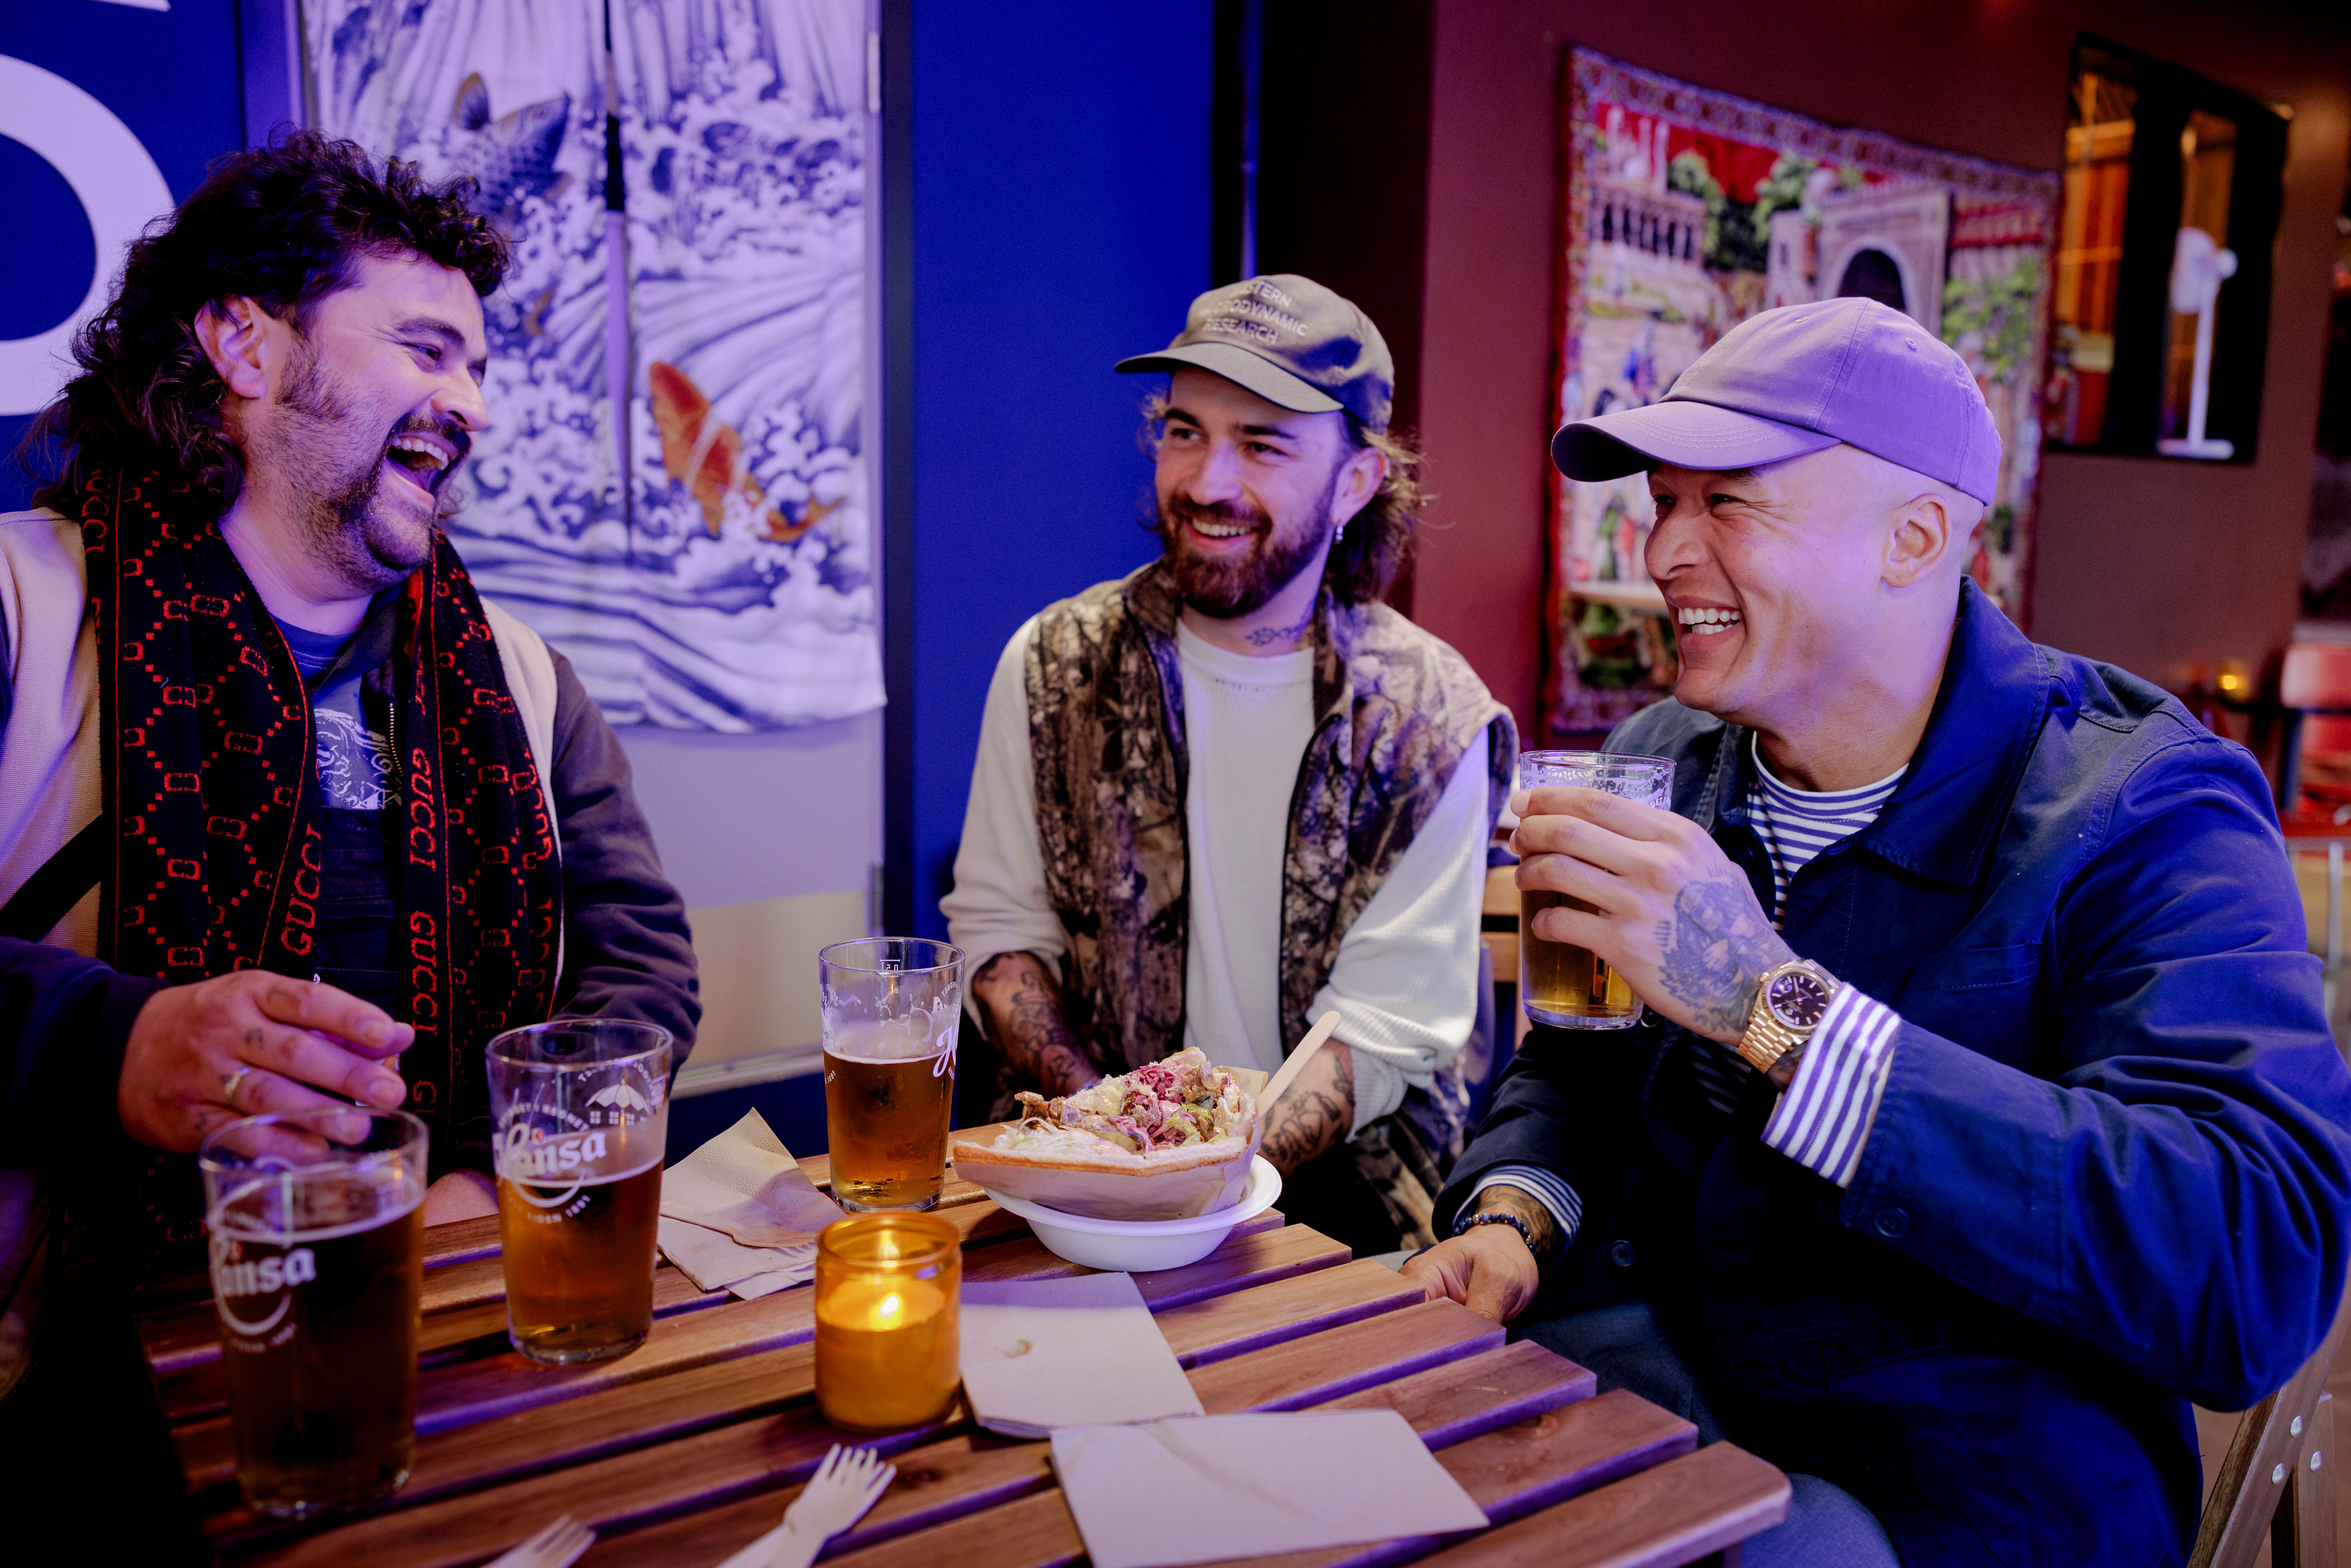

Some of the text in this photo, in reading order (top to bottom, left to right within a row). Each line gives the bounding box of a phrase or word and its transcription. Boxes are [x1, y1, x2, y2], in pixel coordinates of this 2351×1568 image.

[410, 747, 436, 873] GUCCI
[280, 821, 322, 956] GUCCI
[410, 910, 437, 1037] GUCCI
[827, 1070, 836, 1084] 1891
